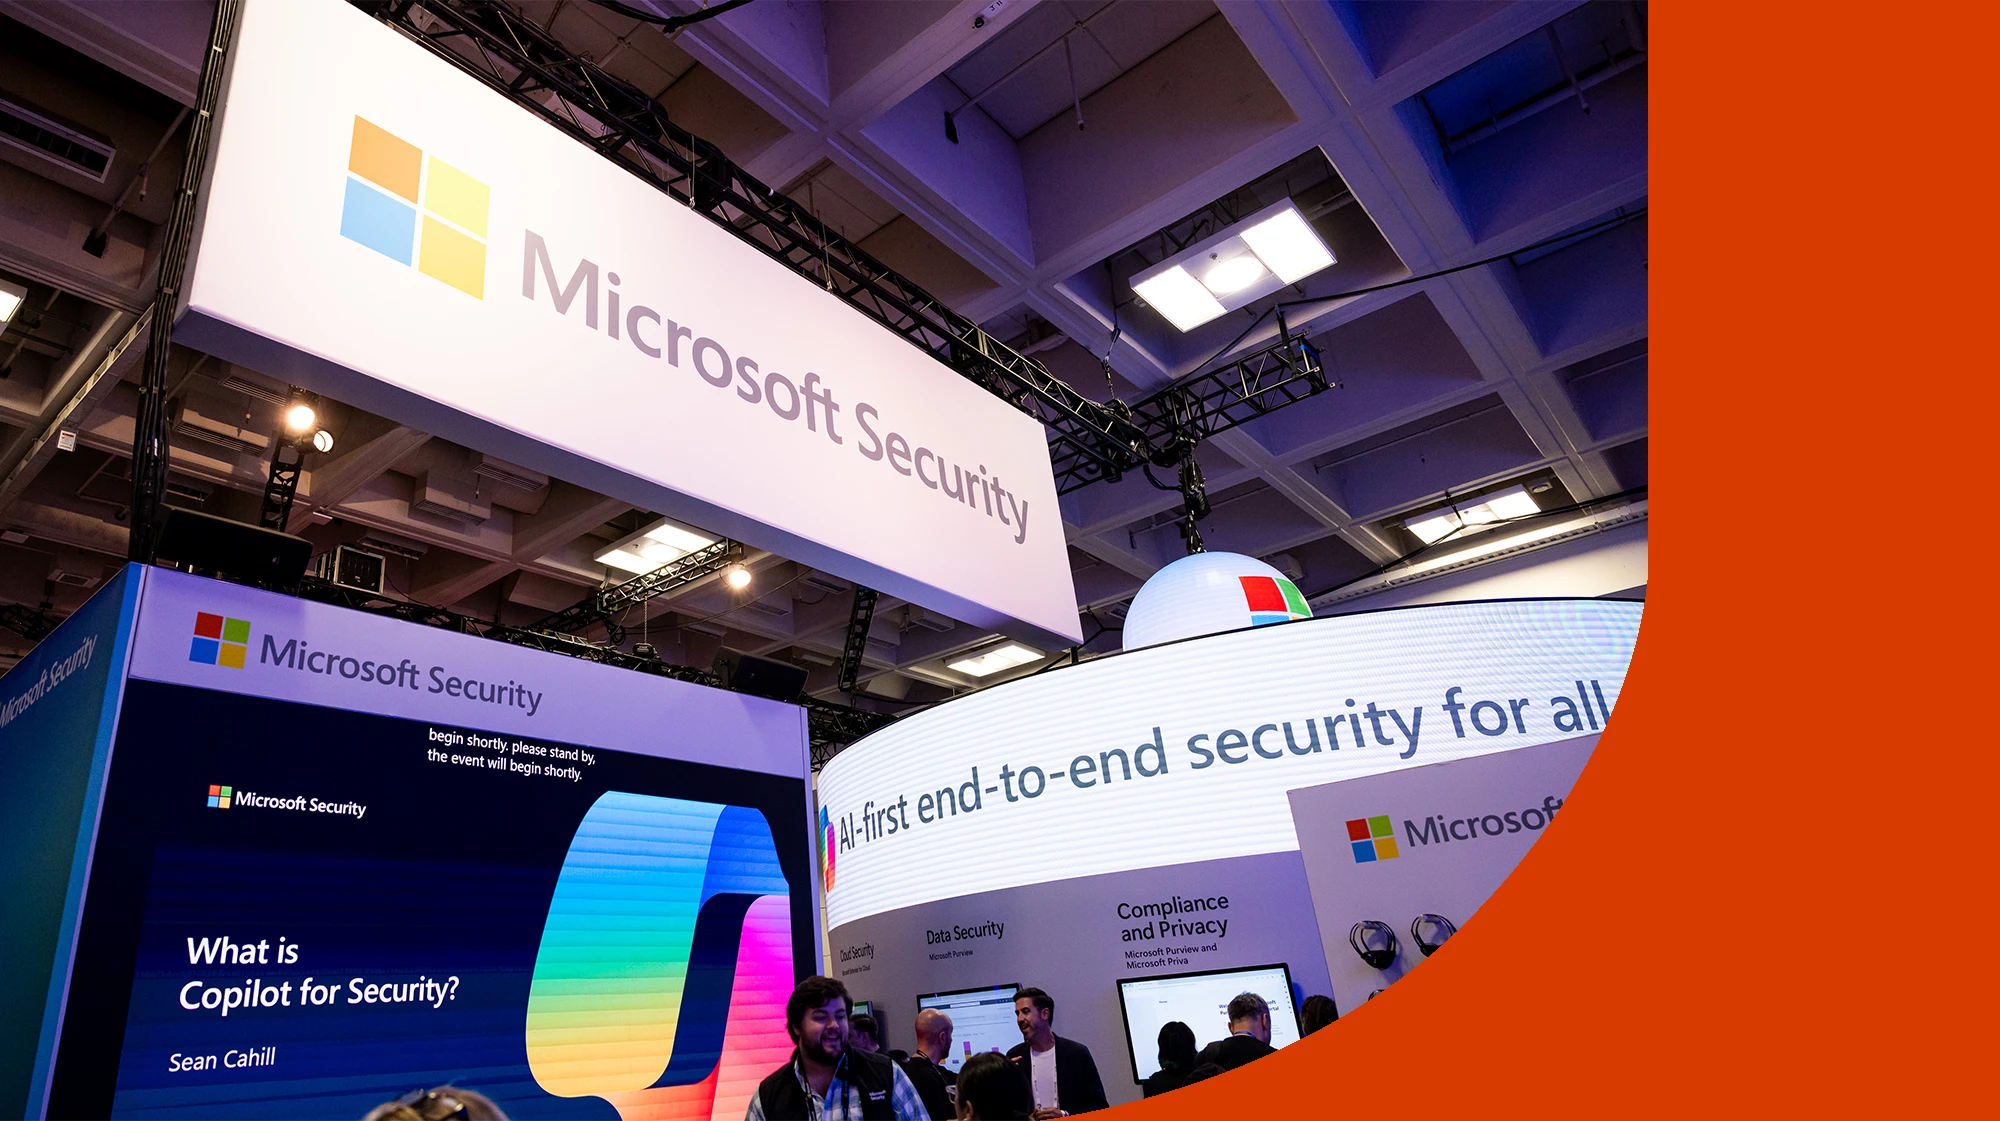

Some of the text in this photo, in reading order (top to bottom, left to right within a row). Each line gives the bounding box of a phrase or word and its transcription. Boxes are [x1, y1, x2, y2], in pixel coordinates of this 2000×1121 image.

[522, 228, 1029, 545] Microsoft Security
[0, 634, 98, 728] Microsoft Security
[260, 634, 542, 717] Microsoft Security
[429, 728, 596, 766] begin shortly. please stand by,
[427, 748, 582, 783] the event will begin shortly.
[840, 680, 1611, 854] AI-first end-to-end security for all
[235, 791, 367, 819] Microsoft Security
[1404, 796, 1563, 847] Microsof
[1117, 895, 1229, 920] Compliance
[926, 920, 1004, 945] Data Security
[1121, 918, 1228, 942] and Privacy
[187, 936, 299, 965] What is
[852, 942, 875, 959] Security
[1124, 943, 1218, 959] Microsoft Purview and
[1126, 957, 1189, 969] Microsoft Priva
[179, 975, 460, 1017] Copilot for Security?
[168, 1047, 276, 1073] Sean Cahill
